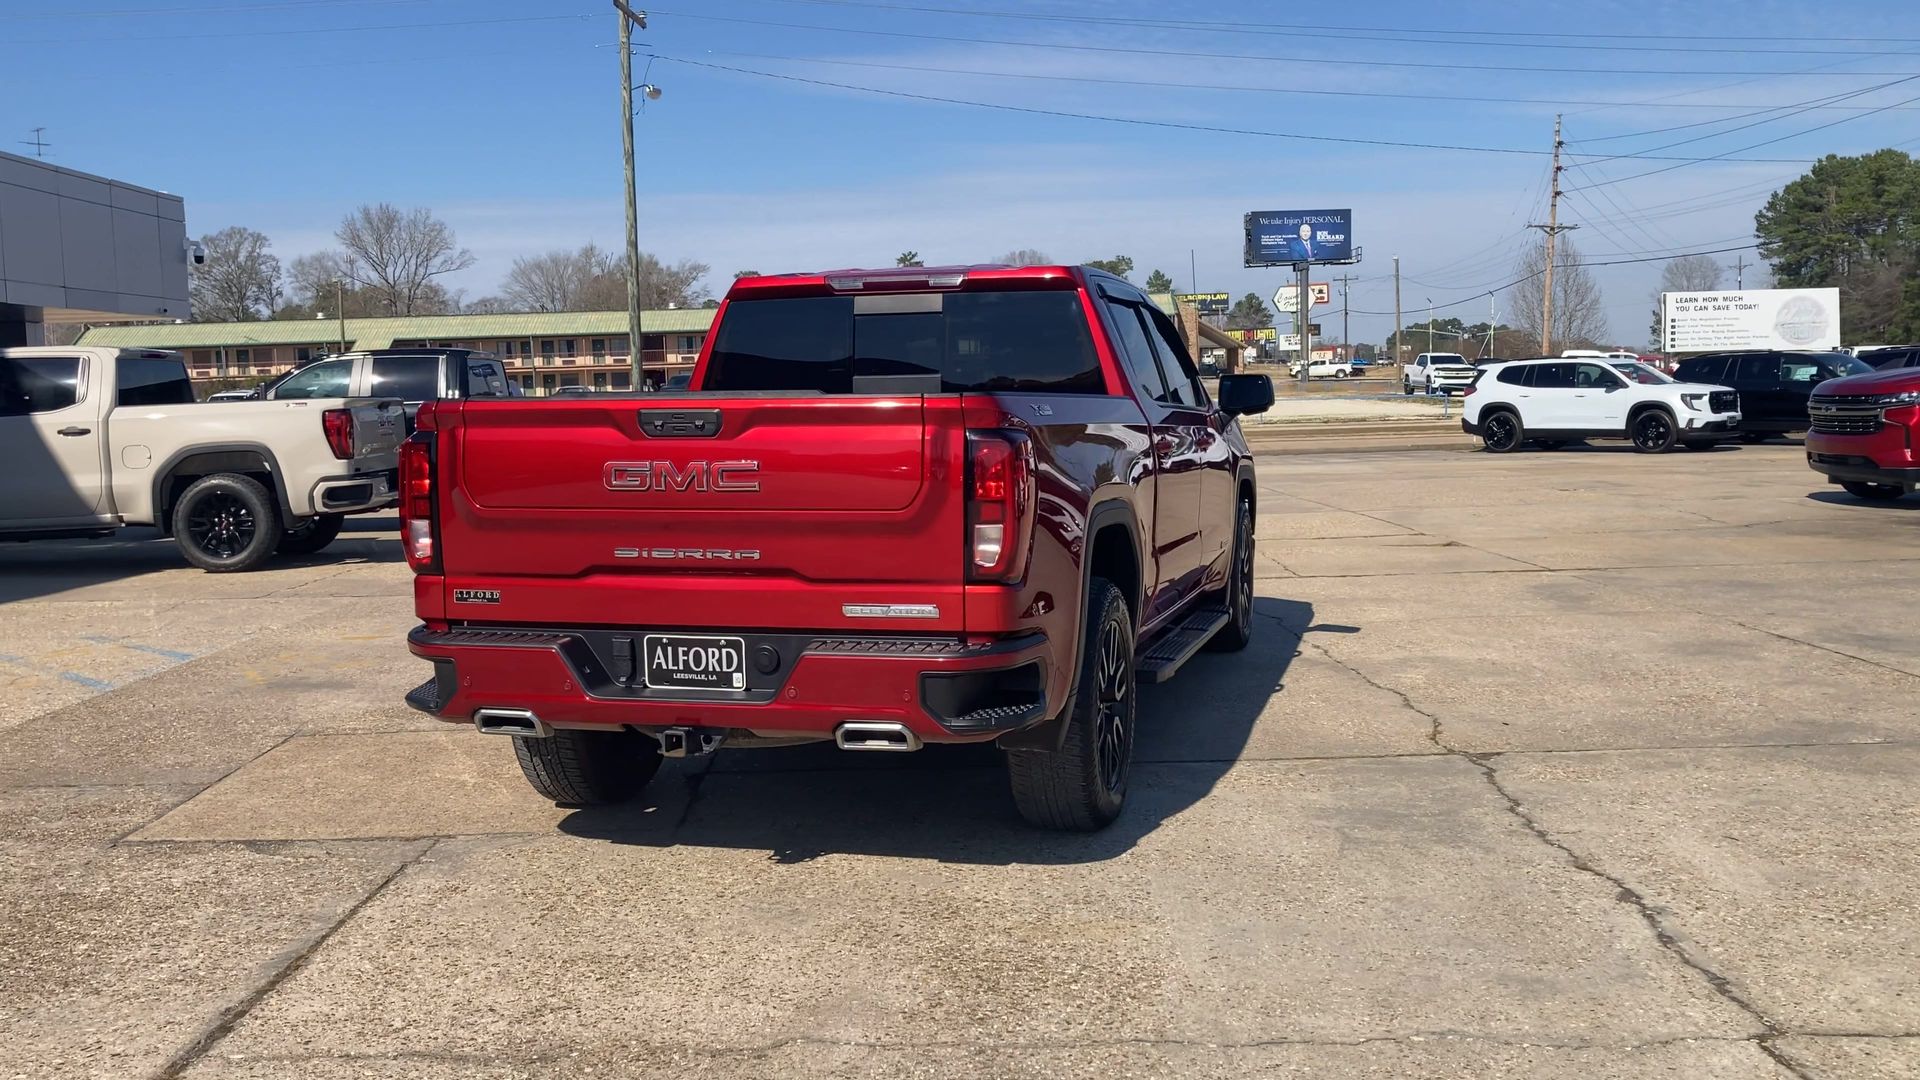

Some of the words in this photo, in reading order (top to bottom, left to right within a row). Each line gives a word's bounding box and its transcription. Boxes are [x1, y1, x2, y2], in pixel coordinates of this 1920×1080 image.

[1259, 217, 1271, 225] We
[1271, 217, 1283, 225] take
[1284, 216, 1302, 226] Injury
[603, 460, 760, 492] GMC
[614, 547, 760, 560] SIERRA
[456, 590, 499, 599] ALFORD
[845, 606, 936, 616] ELEVATION
[652, 645, 738, 672] ALFORD
[673, 672, 708, 681] LEESVILLE,
